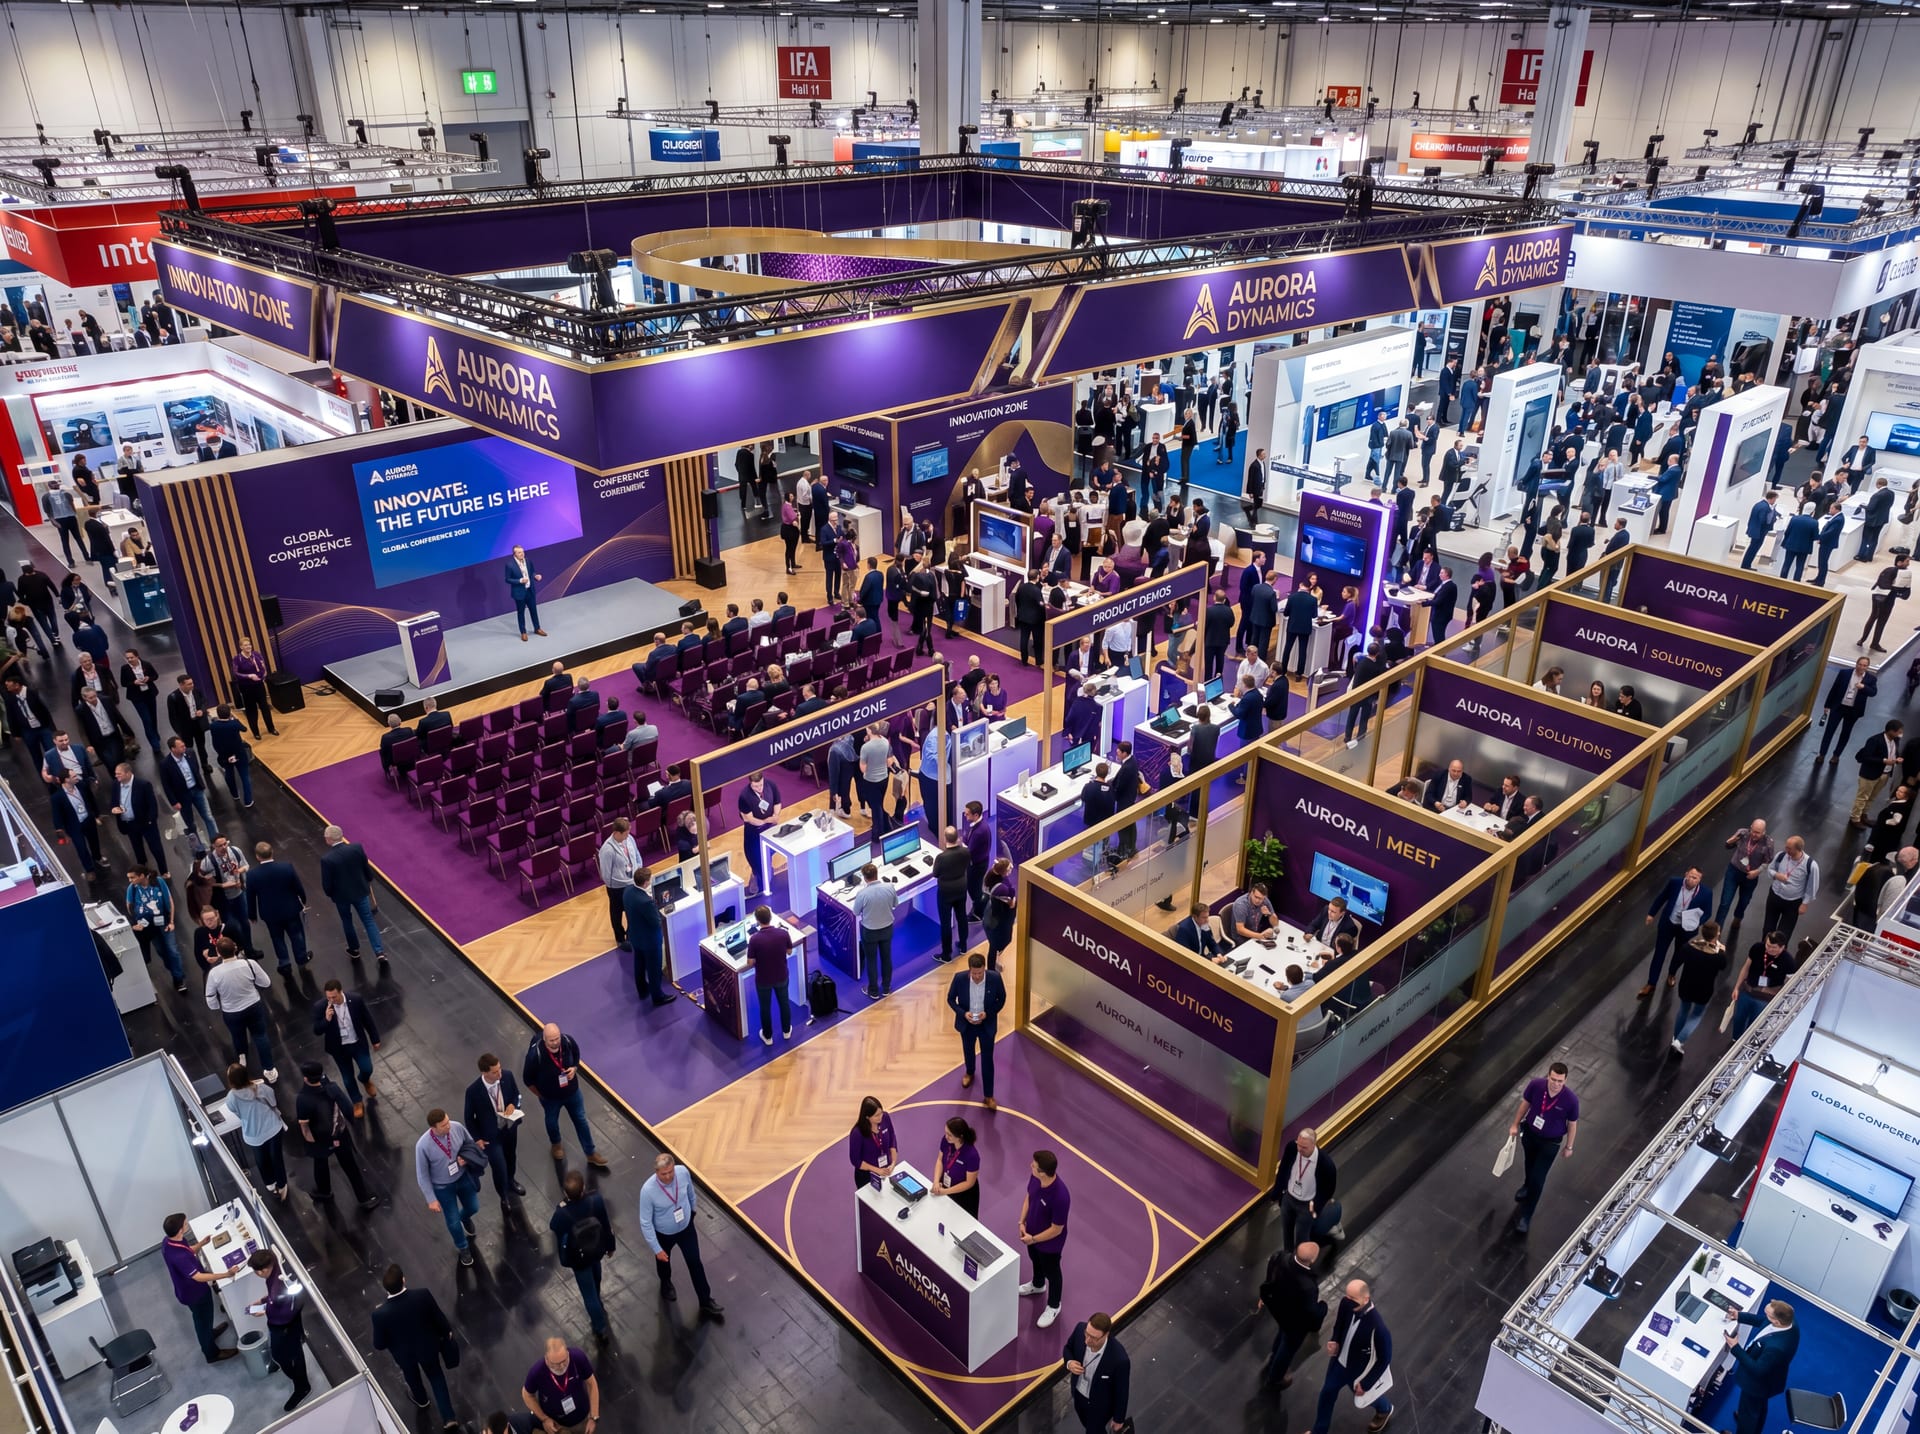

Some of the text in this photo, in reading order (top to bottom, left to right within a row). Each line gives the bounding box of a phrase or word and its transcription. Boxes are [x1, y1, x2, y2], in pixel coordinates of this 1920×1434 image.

[790, 52, 818, 76] IFA
[1520, 54, 1543, 80] IF
[792, 84, 820, 96] Hall 11
[1504, 238, 1560, 265] AURORA
[1228, 271, 1316, 306] AURORA
[1501, 260, 1559, 286] DYNAMICS
[167, 264, 294, 330] INNOVATION ZONE
[1227, 298, 1316, 332] DYNAMICS
[458, 348, 556, 408] AURORA
[460, 382, 560, 440] DYNAMICS
[949, 400, 1028, 428] INNOVATION ZONE
[593, 469, 650, 488] CONFERENCE
[374, 482, 468, 514] INNOVATE:
[376, 482, 550, 532] THE FUTURE IS HERE
[268, 536, 352, 563] CONFERENCE
[283, 528, 334, 546] GLOBAL
[298, 556, 328, 570] 2024
[1092, 585, 1172, 626] PRODUCT DEMOS
[1664, 580, 1789, 620] AURORA MEET
[1575, 627, 1723, 678] AURORA SOLUTIONS
[770, 698, 888, 756] INNOVATION ZONE
[1456, 698, 1612, 760] AURORA SOLUTIONS
[1295, 798, 1440, 870] AURORA MEET
[1062, 925, 1233, 1033] AURORA SOLUTIONS
[1096, 1000, 1184, 1060] AURORA MEET
[896, 1252, 950, 1308] AURORA
